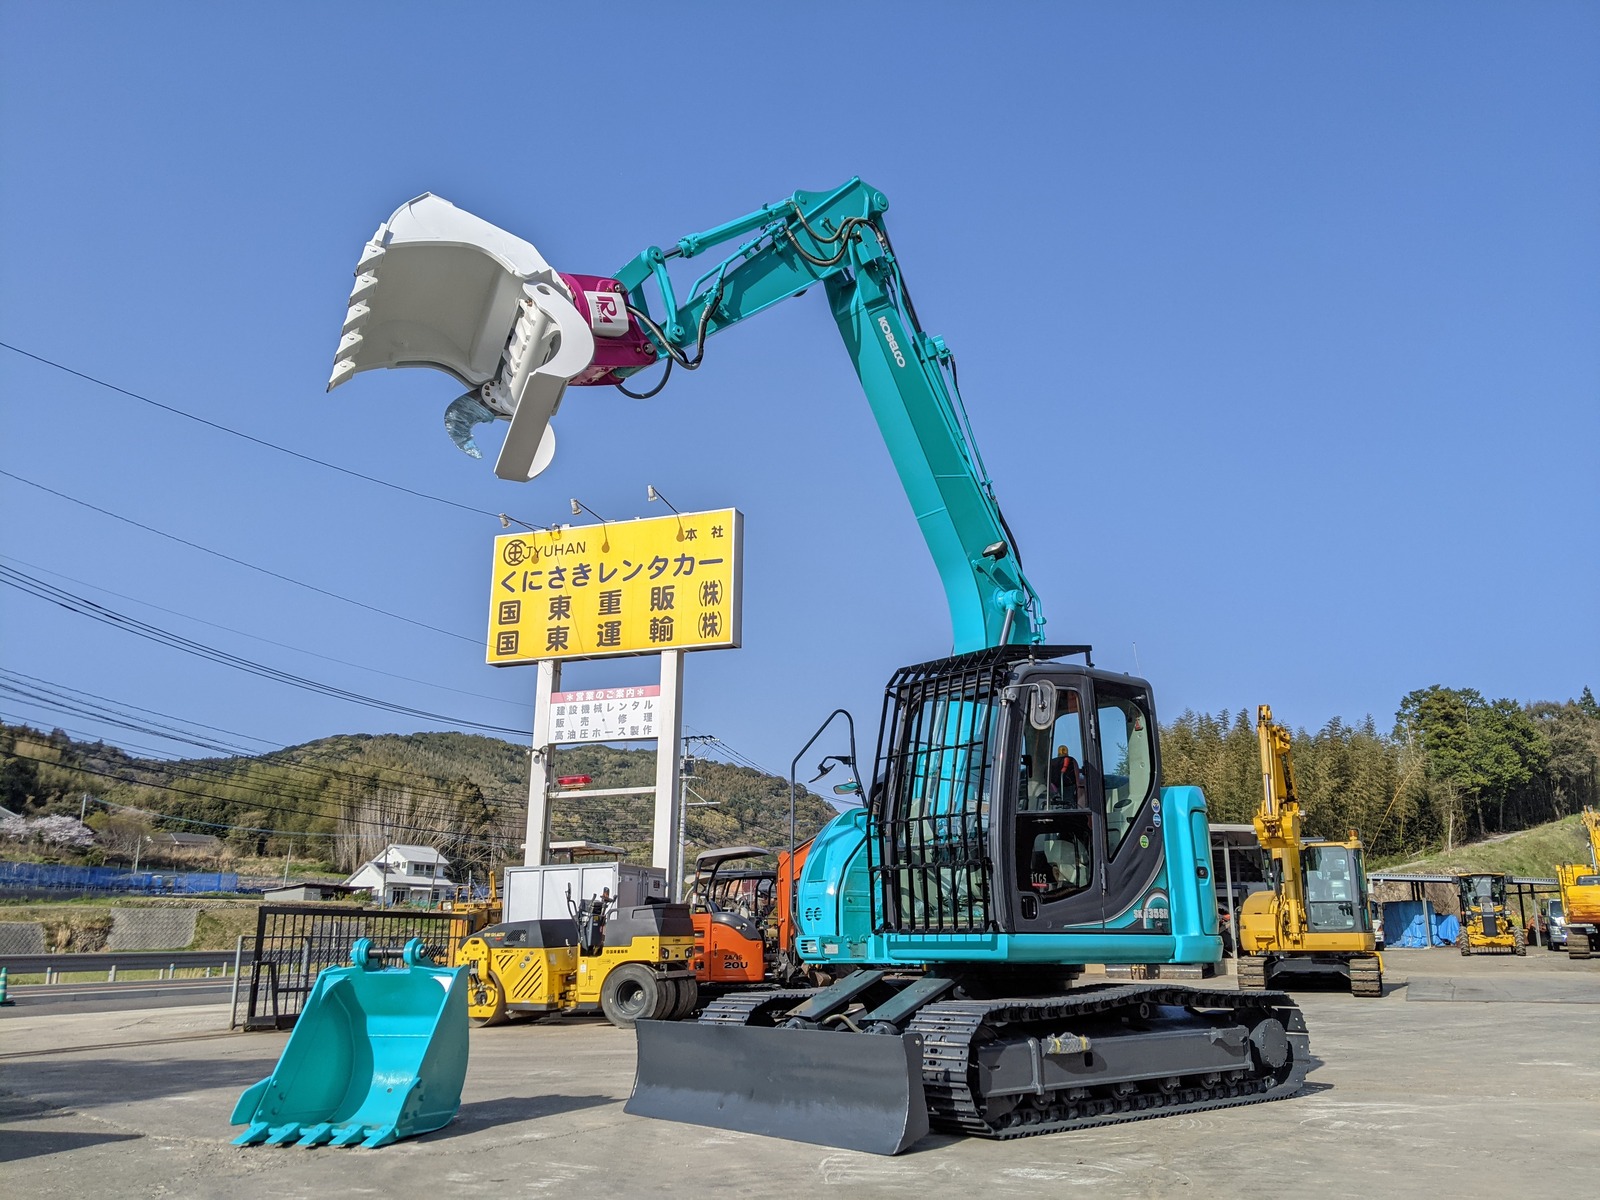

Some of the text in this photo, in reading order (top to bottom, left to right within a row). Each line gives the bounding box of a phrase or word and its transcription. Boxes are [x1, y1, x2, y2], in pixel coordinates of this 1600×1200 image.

[878, 316, 906, 368] KOBELCO
[684, 525, 724, 541] 本社
[500, 553, 724, 593] くにさきレンタカー
[556, 700, 654, 716] 建設機械レンタル
[554, 725, 652, 741] 高油圧ホース製作
[724, 961, 748, 969] 20U
